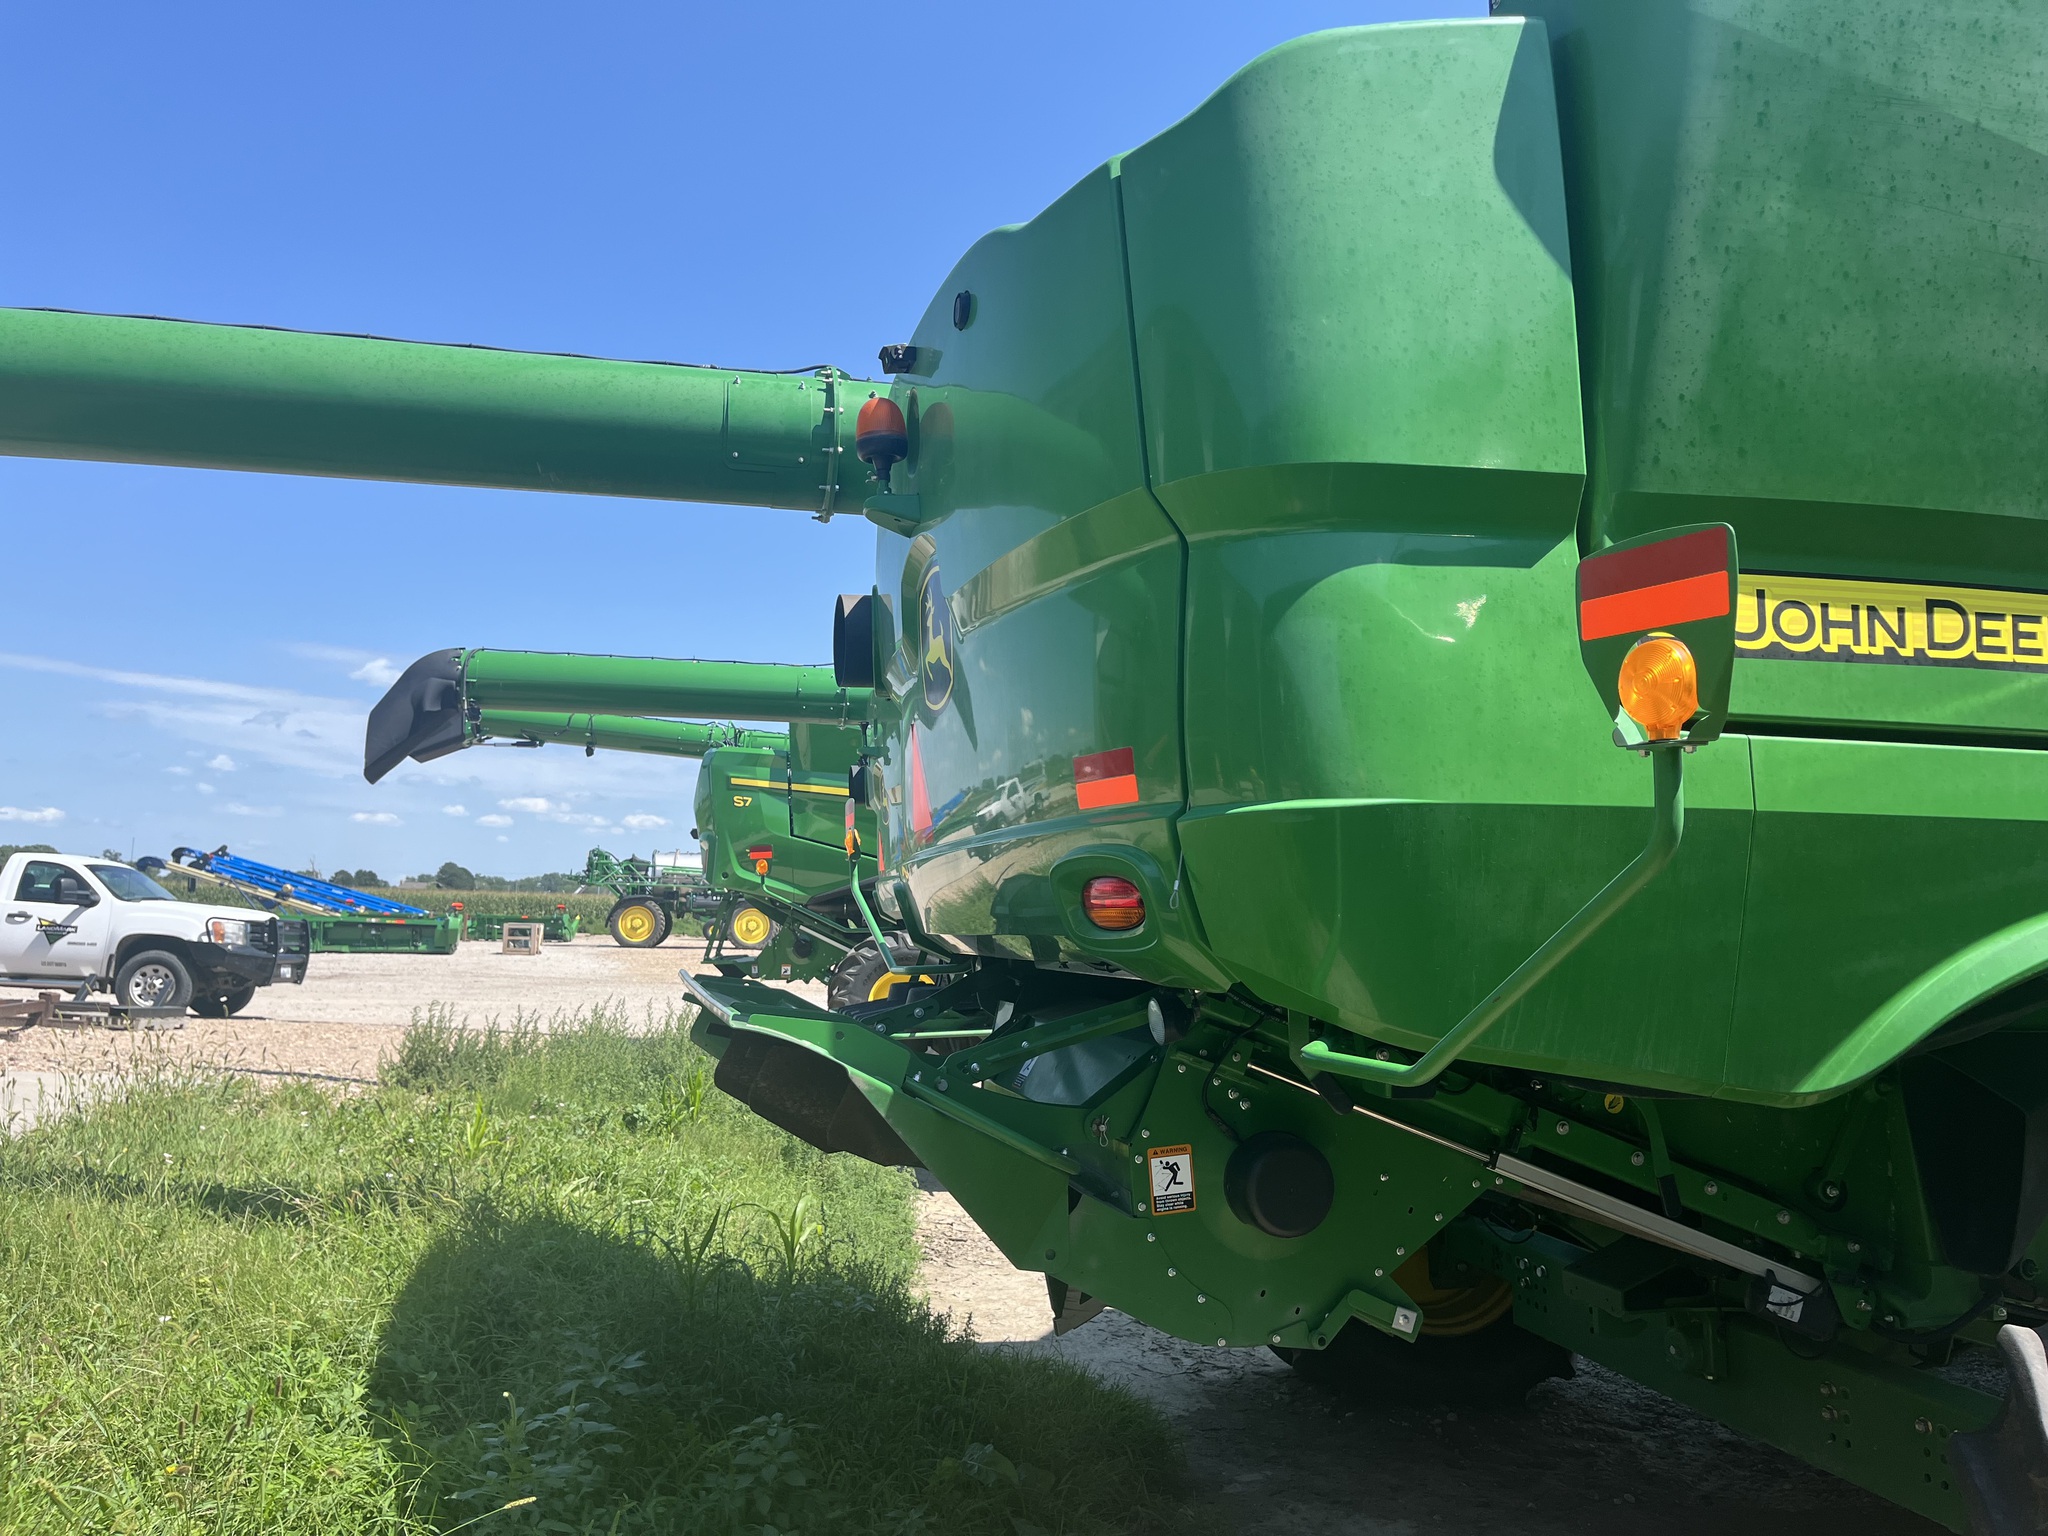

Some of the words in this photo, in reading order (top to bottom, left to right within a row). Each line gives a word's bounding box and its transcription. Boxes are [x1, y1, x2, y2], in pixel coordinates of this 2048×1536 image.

[1735, 588, 1908, 651] JOHN
[733, 795, 753, 808] S7
[1160, 1146, 1188, 1154] WARNING
